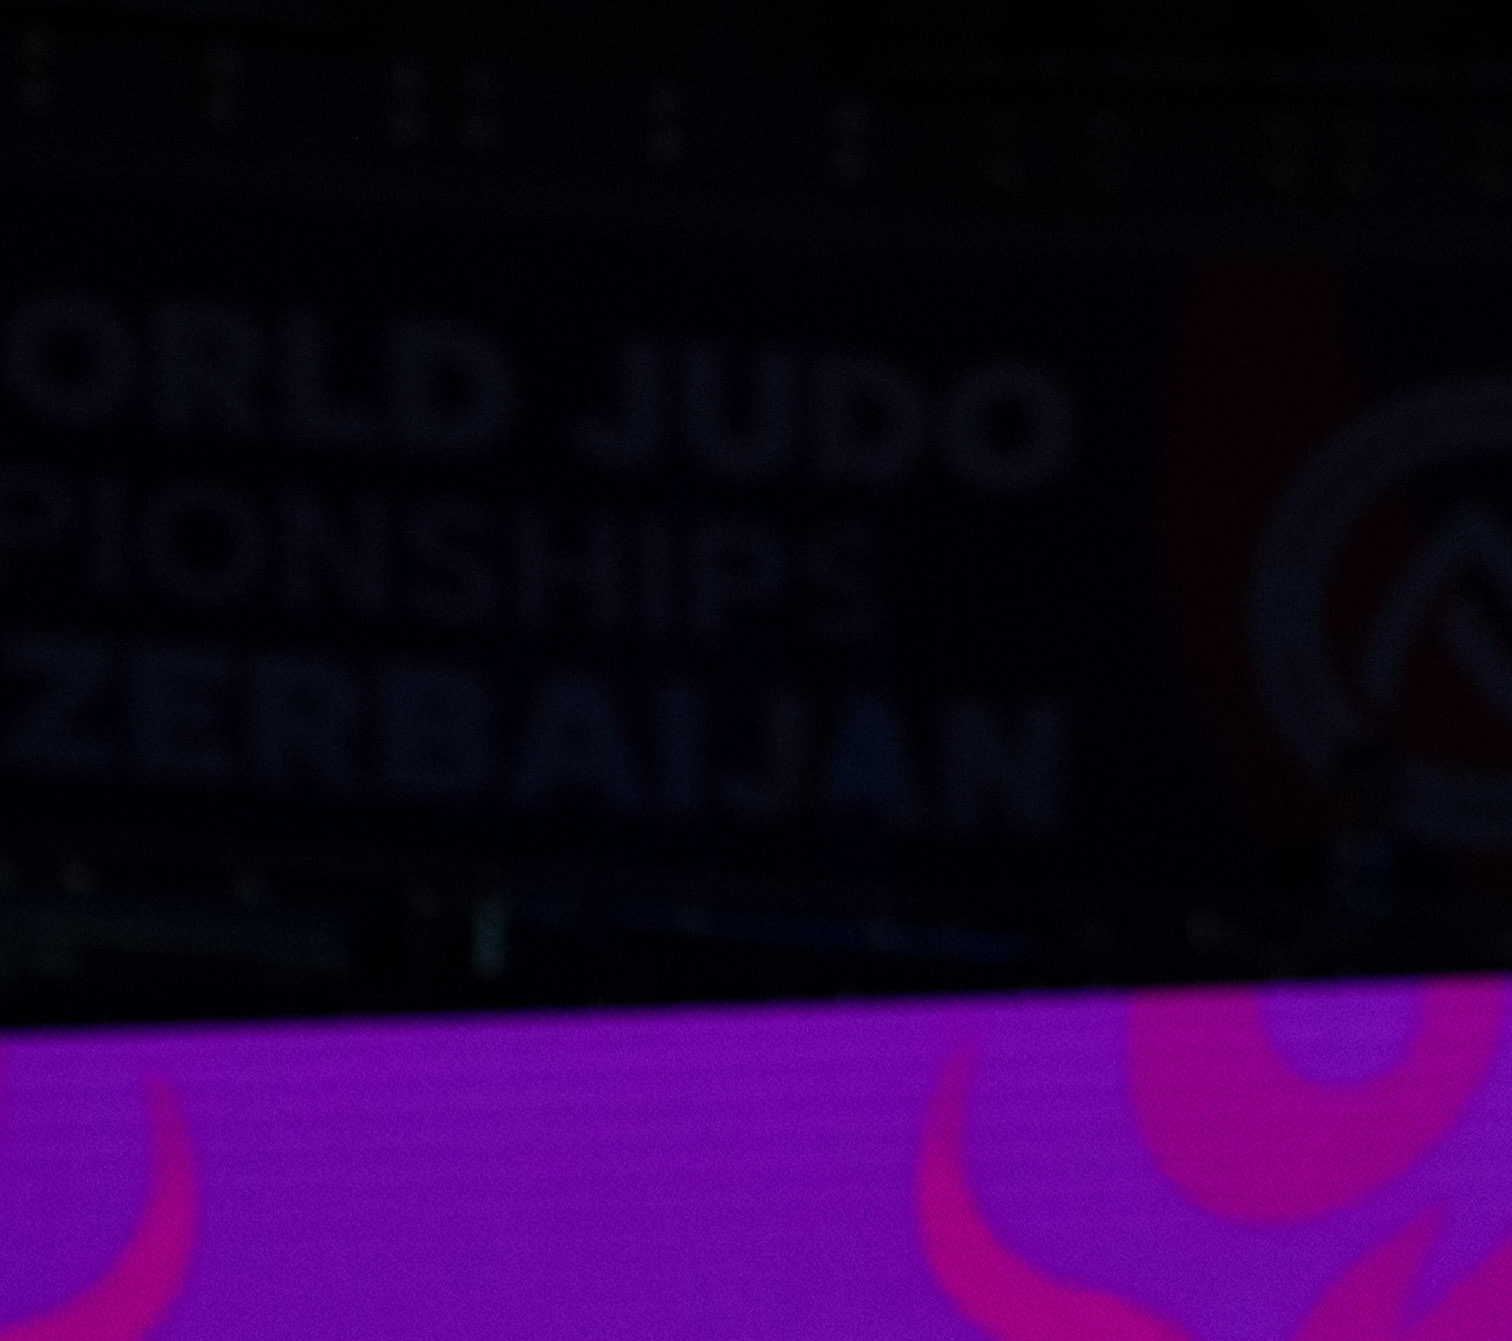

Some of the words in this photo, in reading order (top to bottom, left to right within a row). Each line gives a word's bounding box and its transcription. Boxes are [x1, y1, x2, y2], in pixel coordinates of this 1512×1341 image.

[0, 283, 525, 460] ORLD
[571, 330, 1085, 499] JUDO
[0, 459, 882, 645] PIONSHIPS
[0, 630, 1070, 838] ZERBAIJAN
